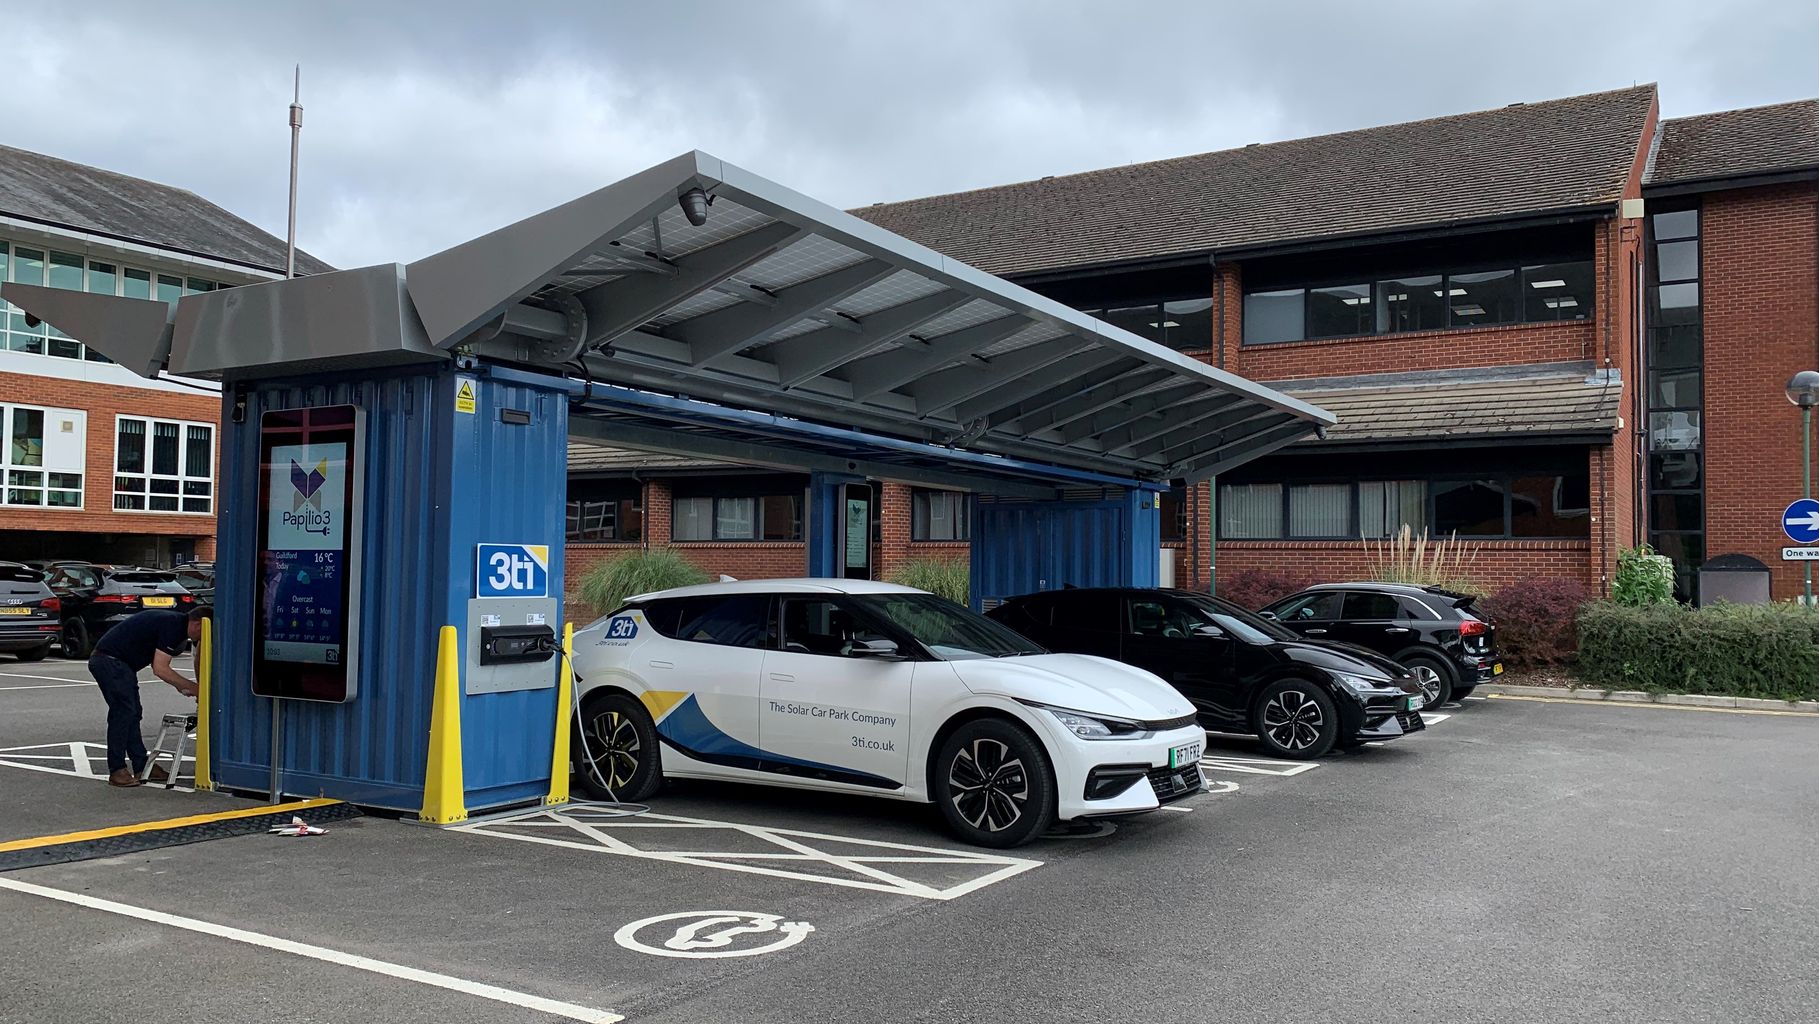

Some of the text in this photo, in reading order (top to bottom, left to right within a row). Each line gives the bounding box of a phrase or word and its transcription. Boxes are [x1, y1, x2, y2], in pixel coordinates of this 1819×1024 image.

[283, 510, 331, 531] Papilio3
[275, 551, 298, 559] Guildford
[314, 552, 334, 563] 16 °C
[275, 562, 289, 570] Today
[489, 551, 534, 590] 3ti
[292, 594, 313, 603] Overcast
[276, 605, 332, 615] Fri Sat Sun Mon
[611, 619, 634, 637] 3ti
[769, 701, 896, 727] The Solar Car Park Company
[851, 736, 895, 752] 3ti.co.uk
